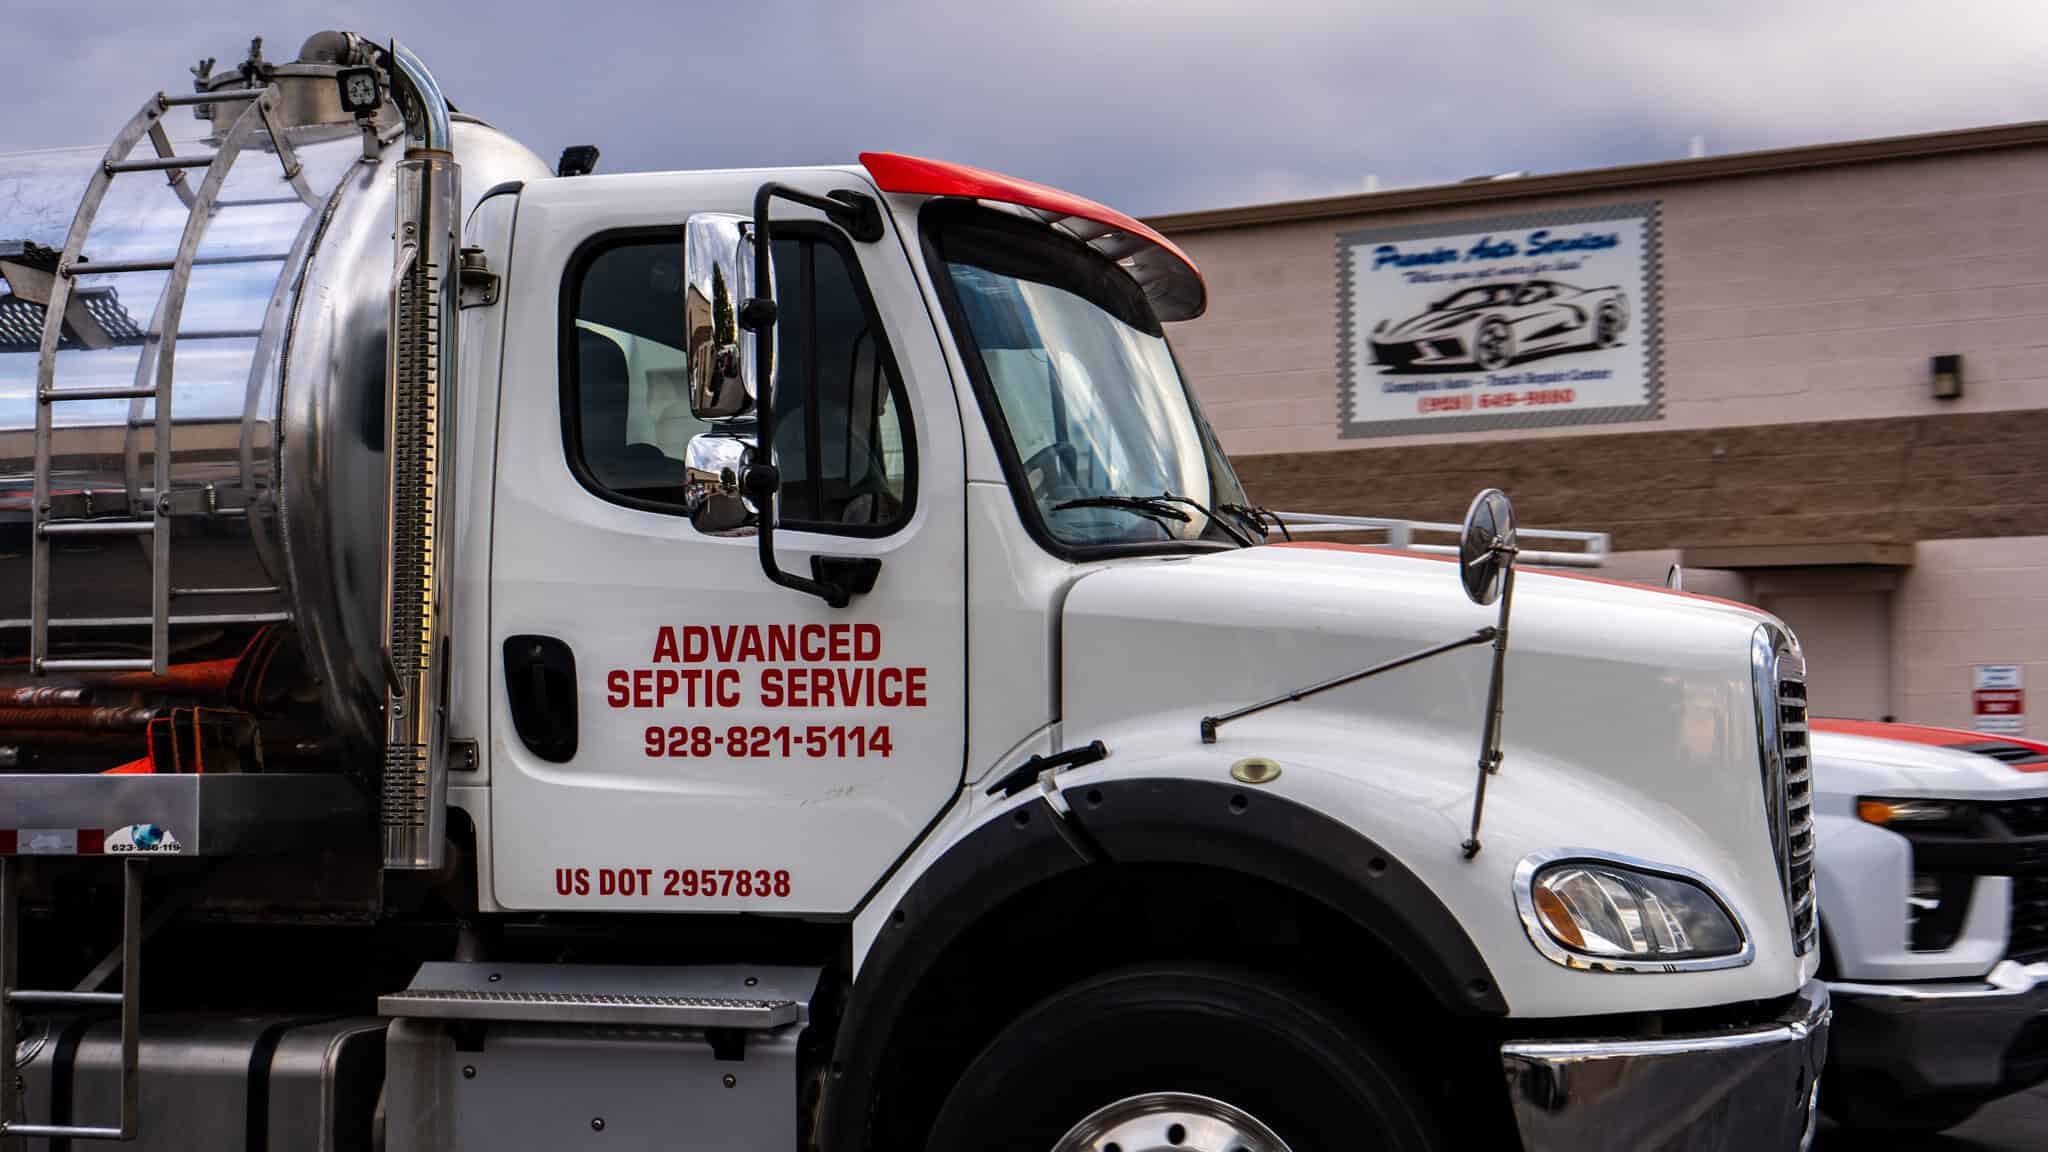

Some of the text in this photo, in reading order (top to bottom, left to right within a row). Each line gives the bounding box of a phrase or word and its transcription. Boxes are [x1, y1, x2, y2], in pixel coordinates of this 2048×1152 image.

[1461, 235, 1519, 260] Auto
[652, 623, 881, 664] ADVANCED
[607, 666, 929, 709] SEPTIC SERVICE
[644, 725, 893, 759] 928-821-5114
[556, 868, 791, 897] US DOT 2957838
